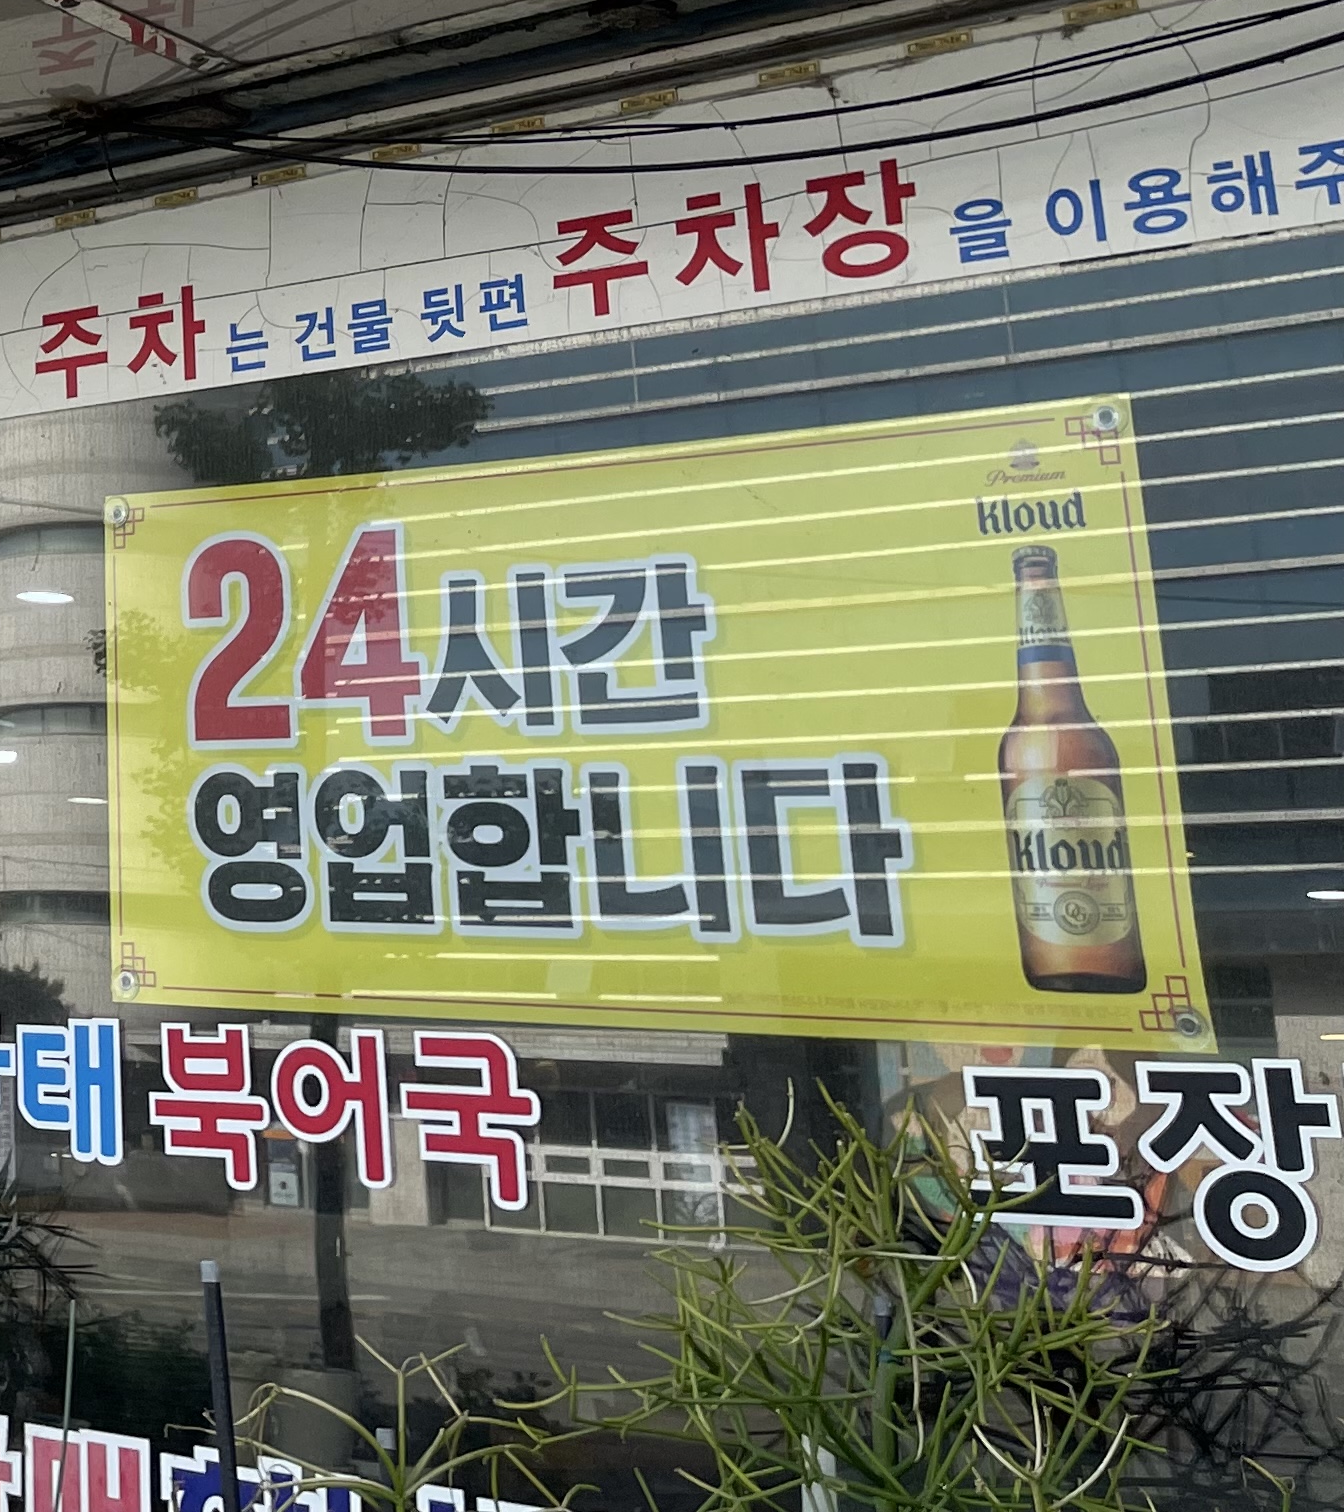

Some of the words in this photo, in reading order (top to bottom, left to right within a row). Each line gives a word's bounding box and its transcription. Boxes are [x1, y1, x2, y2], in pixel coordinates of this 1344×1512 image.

[294, 298, 393, 363] 건물
[420, 273, 529, 341] 뒷편
[975, 489, 1086, 535] Kloud
[985, 469, 1066, 487] Premium
[182, 524, 712, 746] 24시간
[189, 754, 907, 947] 영업합니다
[1013, 826, 1128, 872] Kloud
[150, 1022, 540, 1211] 북어국
